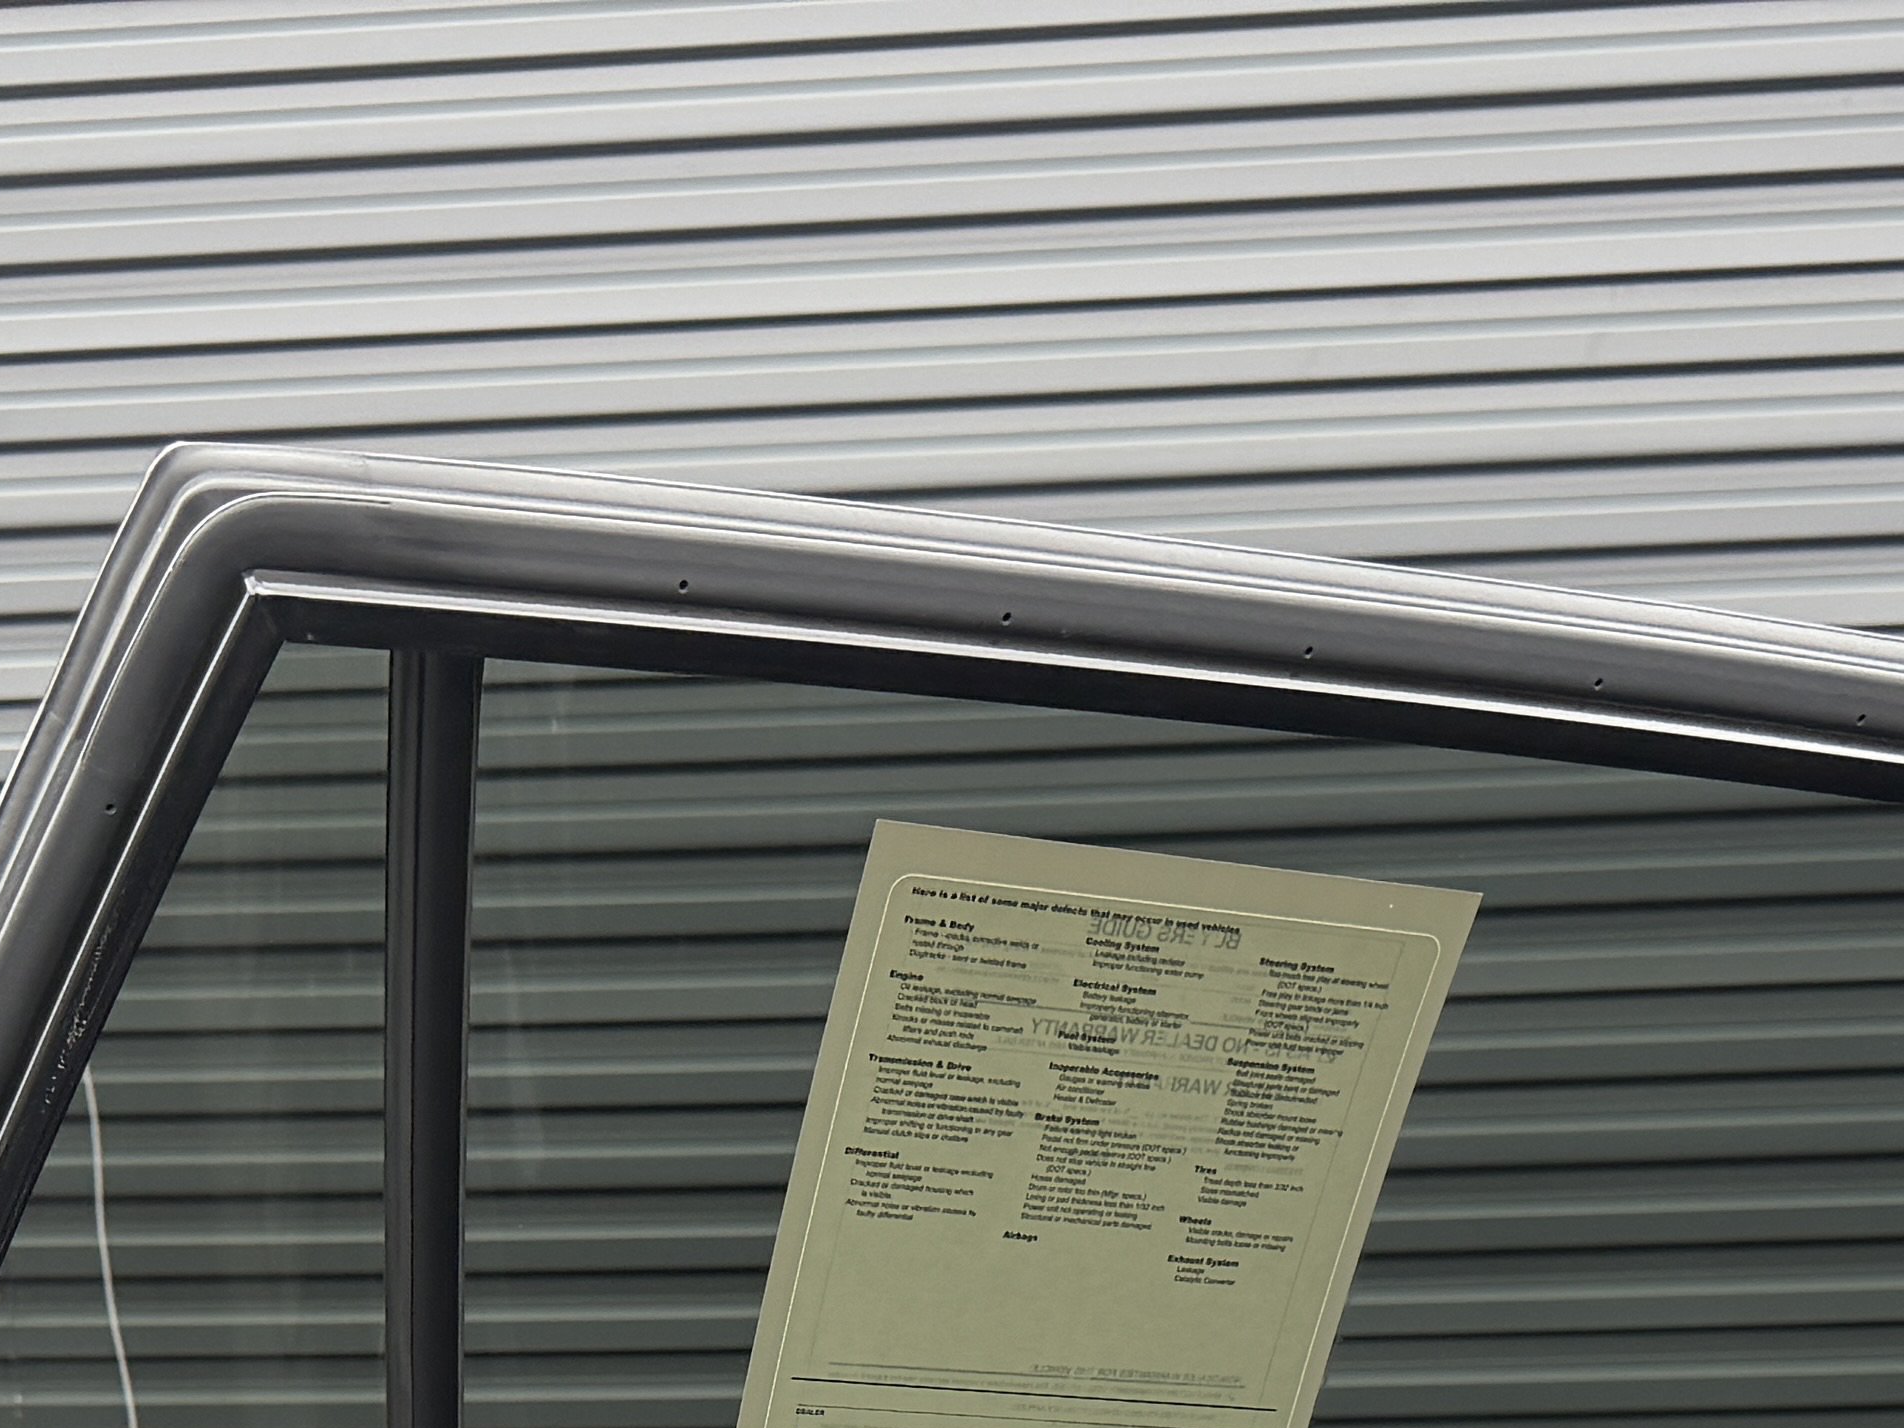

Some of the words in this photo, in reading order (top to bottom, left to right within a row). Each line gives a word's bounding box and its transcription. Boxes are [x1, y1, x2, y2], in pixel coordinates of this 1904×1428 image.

[911, 886, 936, 897] Here
[958, 891, 976, 902] list
[977, 894, 989, 903] of
[1019, 900, 1048, 912] major
[1050, 903, 1087, 916] defects
[1090, 908, 1110, 919] that
[948, 920, 974, 932] Body
[1085, 936, 1122, 950] Cooling
[1124, 941, 1159, 953] System
[1258, 957, 1298, 971] Steering
[1299, 961, 1334, 973] System
[889, 969, 923, 981] Engine
[1072, 978, 1120, 991] Electrical
[1121, 983, 1156, 995] System
[1080, 1031, 1117, 1044] System
[1226, 1057, 1279, 1070] Suspension
[1280, 1063, 1315, 1074] System
[1034, 1112, 1063, 1122] Brake
[1064, 1115, 1100, 1126] System
[844, 1146, 899, 1159] Differential
[1194, 1164, 1217, 1174] Tires
[1178, 1215, 1212, 1225] Wheels
[1002, 1230, 1038, 1242] Airbags
[1166, 1254, 1204, 1264] Exhaust
[1205, 1257, 1239, 1267] System
